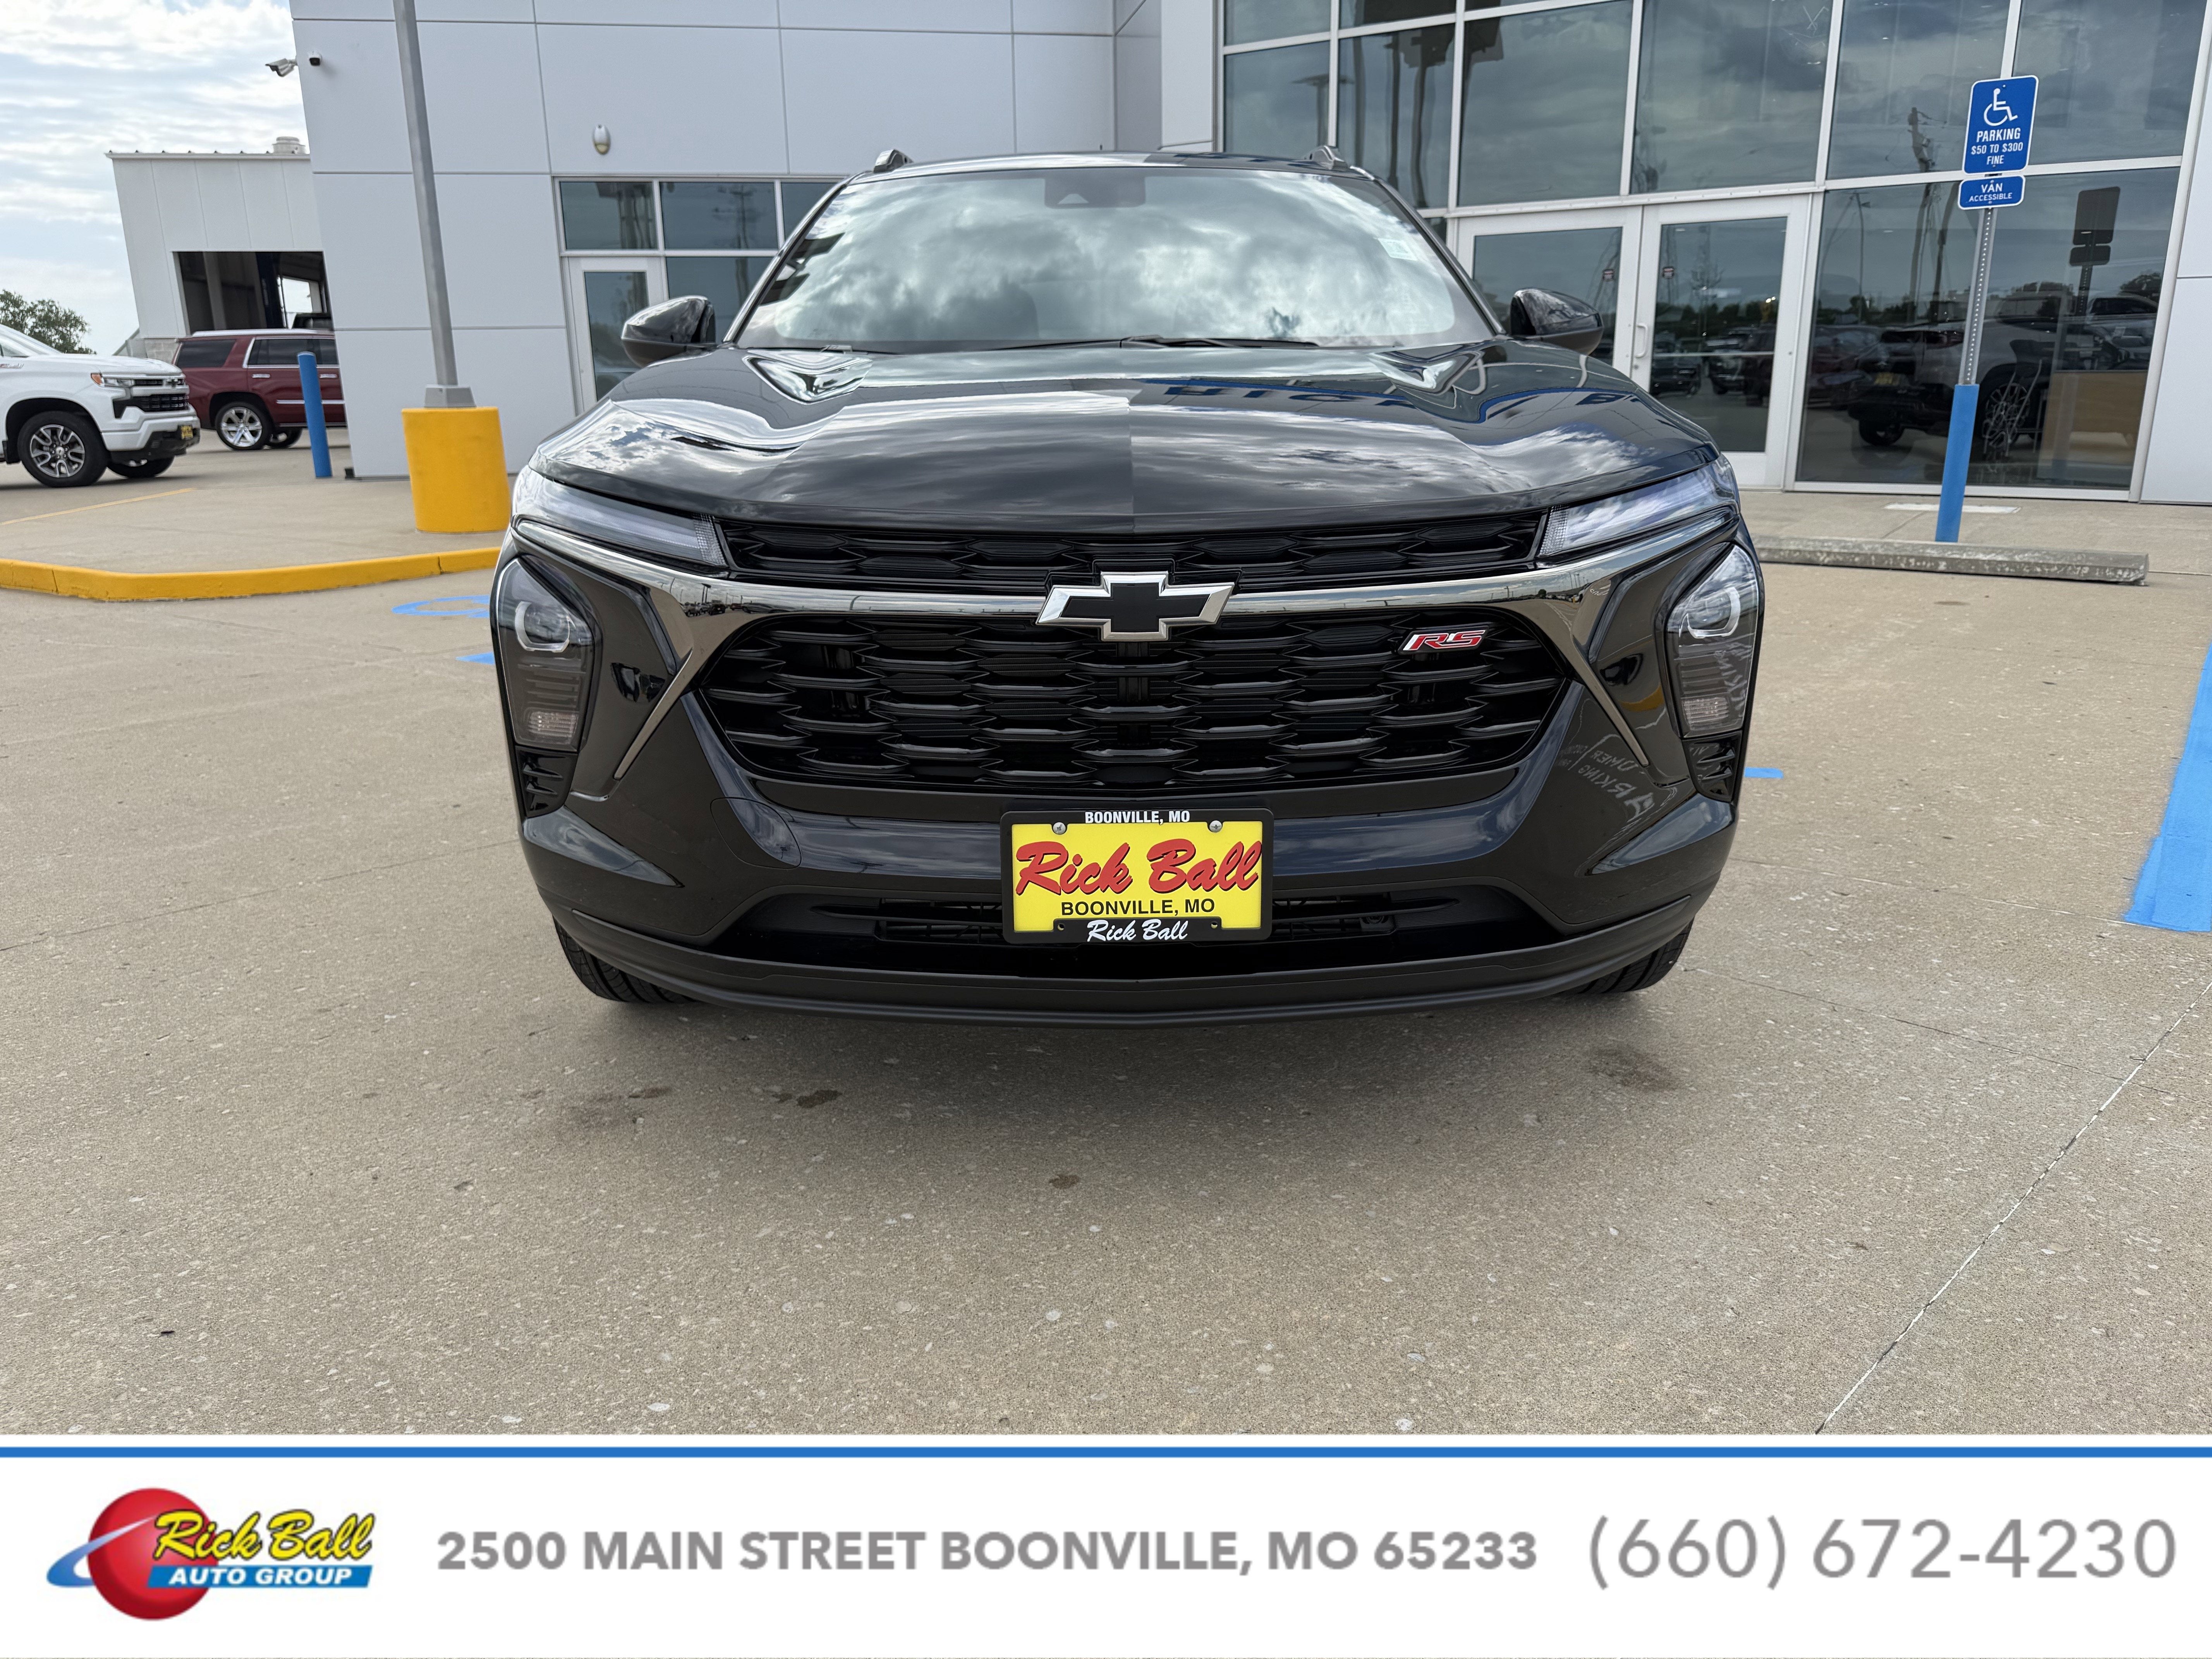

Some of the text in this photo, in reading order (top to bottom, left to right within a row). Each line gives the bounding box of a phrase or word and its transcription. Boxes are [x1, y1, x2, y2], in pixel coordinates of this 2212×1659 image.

[1976, 127, 2021, 143] PARKING
[1971, 142, 2023, 155] $50 TO $300
[1986, 155, 2004, 165] FINE
[1981, 183, 2003, 193] VAN
[1968, 192, 2013, 202] ACCESSIBLE
[1403, 630, 1486, 651] RS
[1085, 810, 1190, 824] BOONVILLE, MO
[1016, 838, 1262, 896] Rick Ball
[1061, 898, 1215, 917] BOONVILLE, MO
[1087, 919, 1188, 942] Rick Ball
